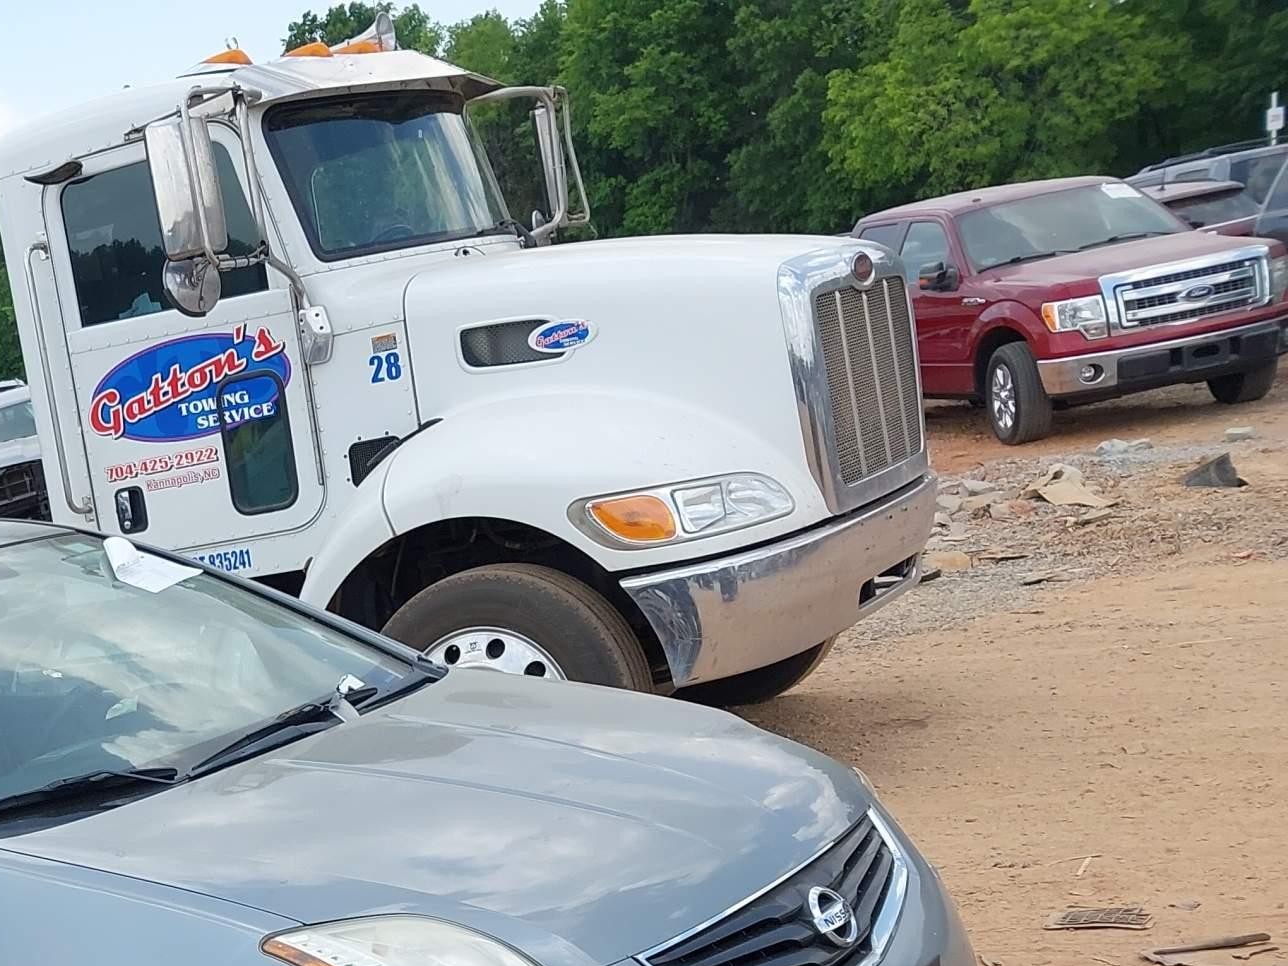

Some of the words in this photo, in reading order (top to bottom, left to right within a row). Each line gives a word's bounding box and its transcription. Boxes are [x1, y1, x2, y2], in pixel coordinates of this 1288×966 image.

[90, 323, 285, 438] Gatton's
[369, 352, 402, 384] 28
[197, 402, 274, 430] SERVICE
[106, 447, 219, 482] 704-425-2922
[209, 549, 251, 571] 835241
[823, 906, 850, 928] NISS
